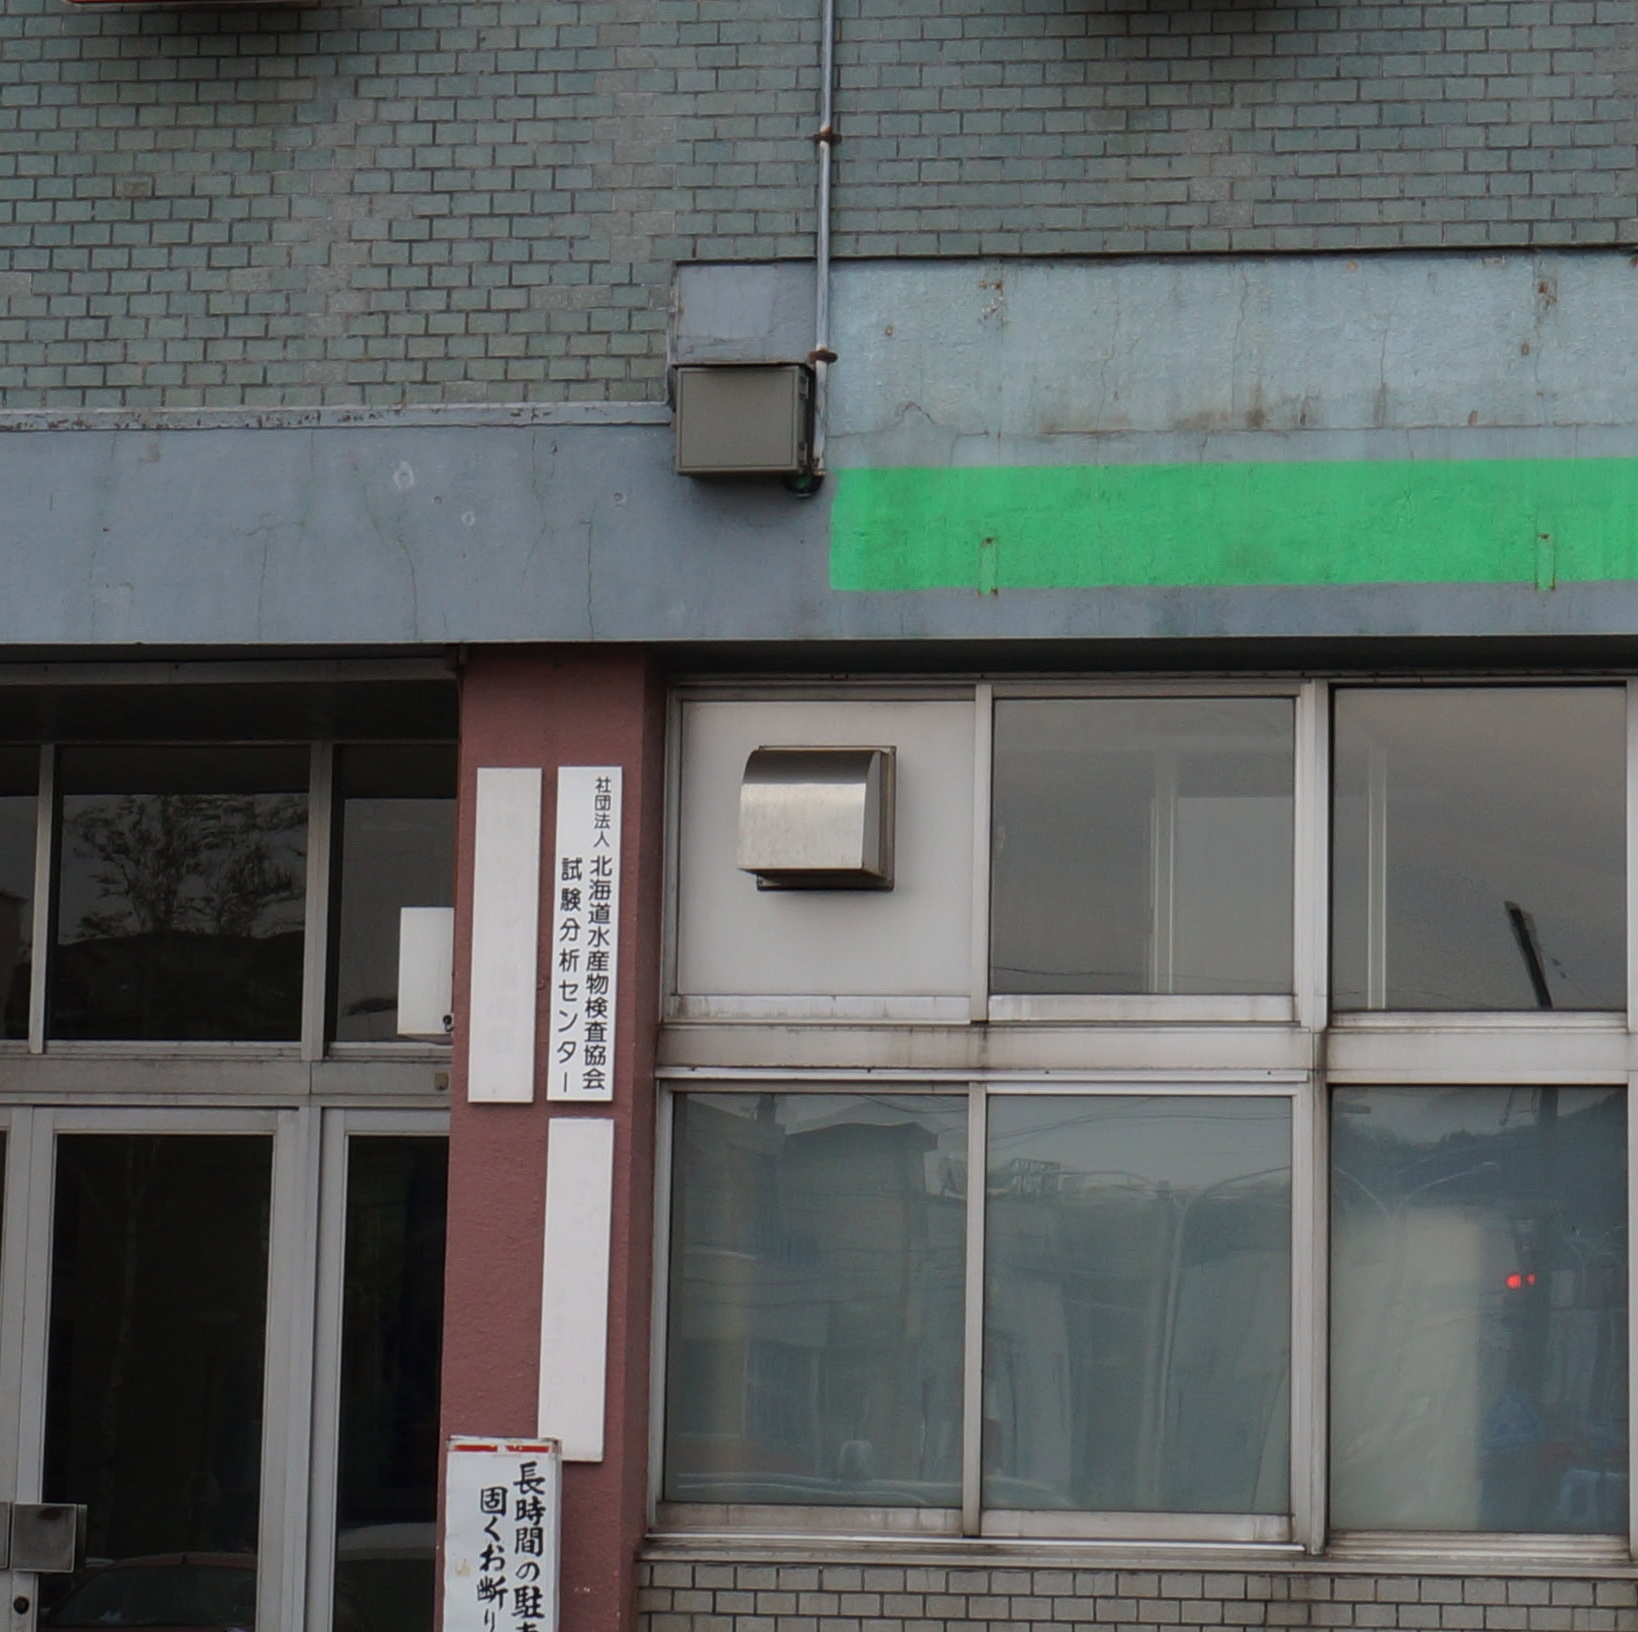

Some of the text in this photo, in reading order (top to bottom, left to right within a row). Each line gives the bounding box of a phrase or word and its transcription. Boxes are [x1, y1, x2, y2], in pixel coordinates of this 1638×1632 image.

[556, 856, 583, 1093] 試験分析センター
[582, 776, 613, 1090] 社団法人 北海道水産物検査協会
